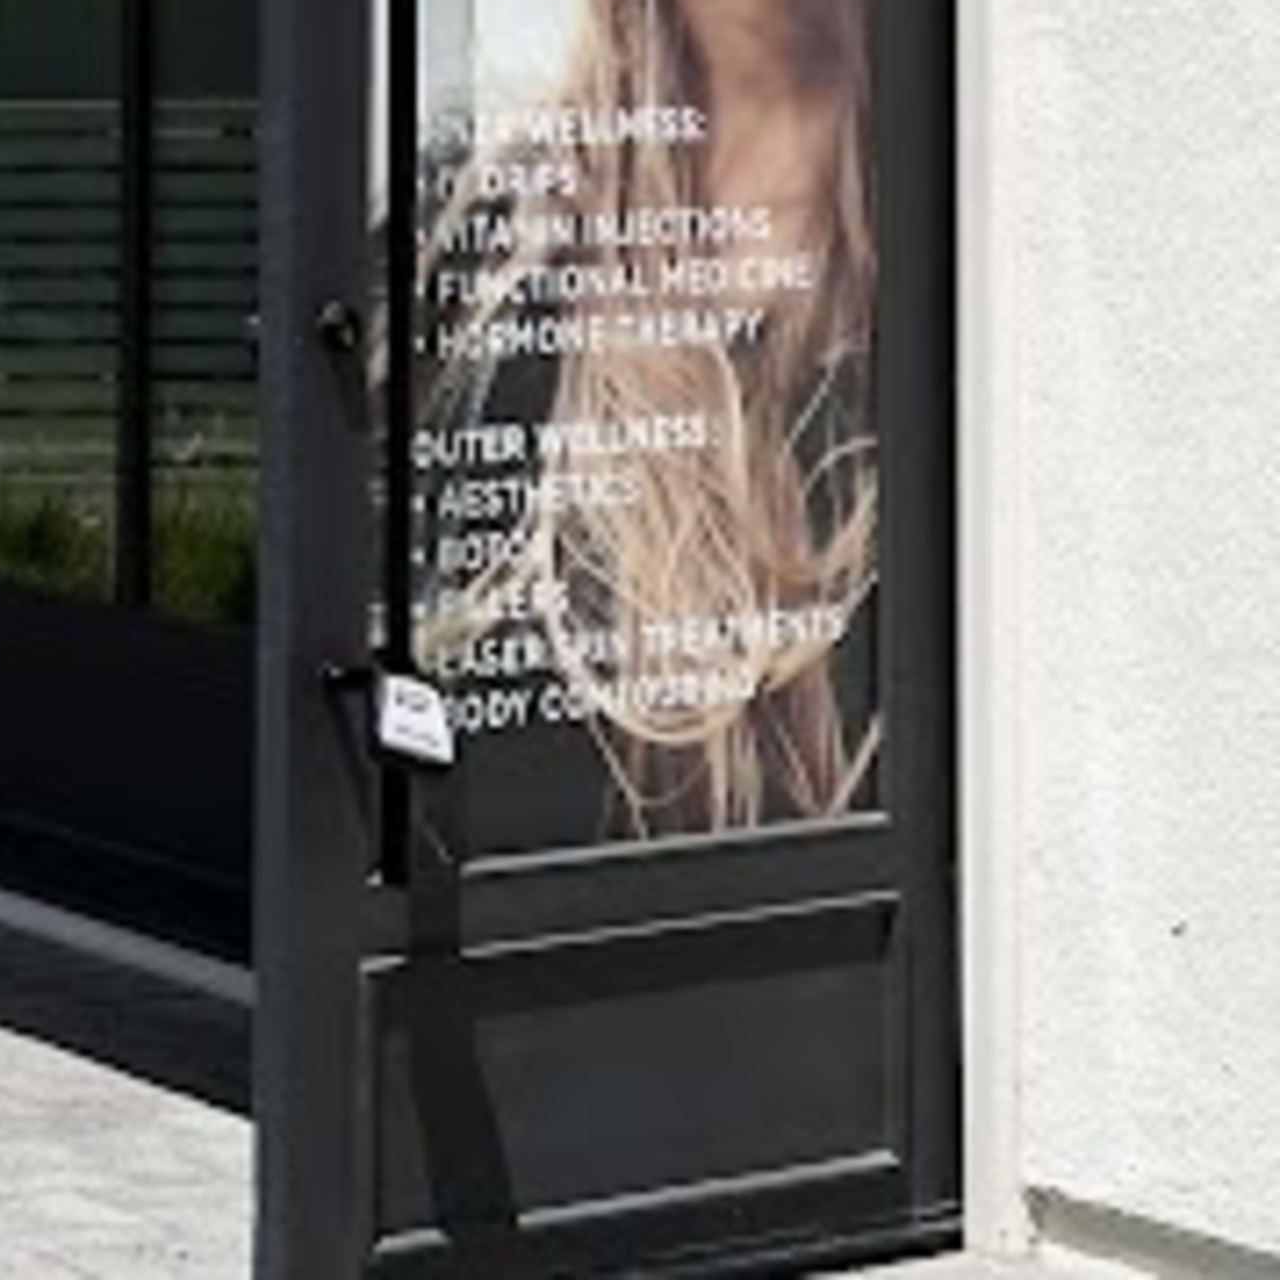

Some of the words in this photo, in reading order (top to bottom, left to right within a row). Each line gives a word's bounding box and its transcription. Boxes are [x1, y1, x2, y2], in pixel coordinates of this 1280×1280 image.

[580, 206, 772, 246] INJECTIONS
[440, 264, 648, 304] FUNCTIONAL
[660, 253, 816, 296] MEDICINE
[440, 316, 605, 359] HORMONE
[412, 424, 527, 469] OUTER
